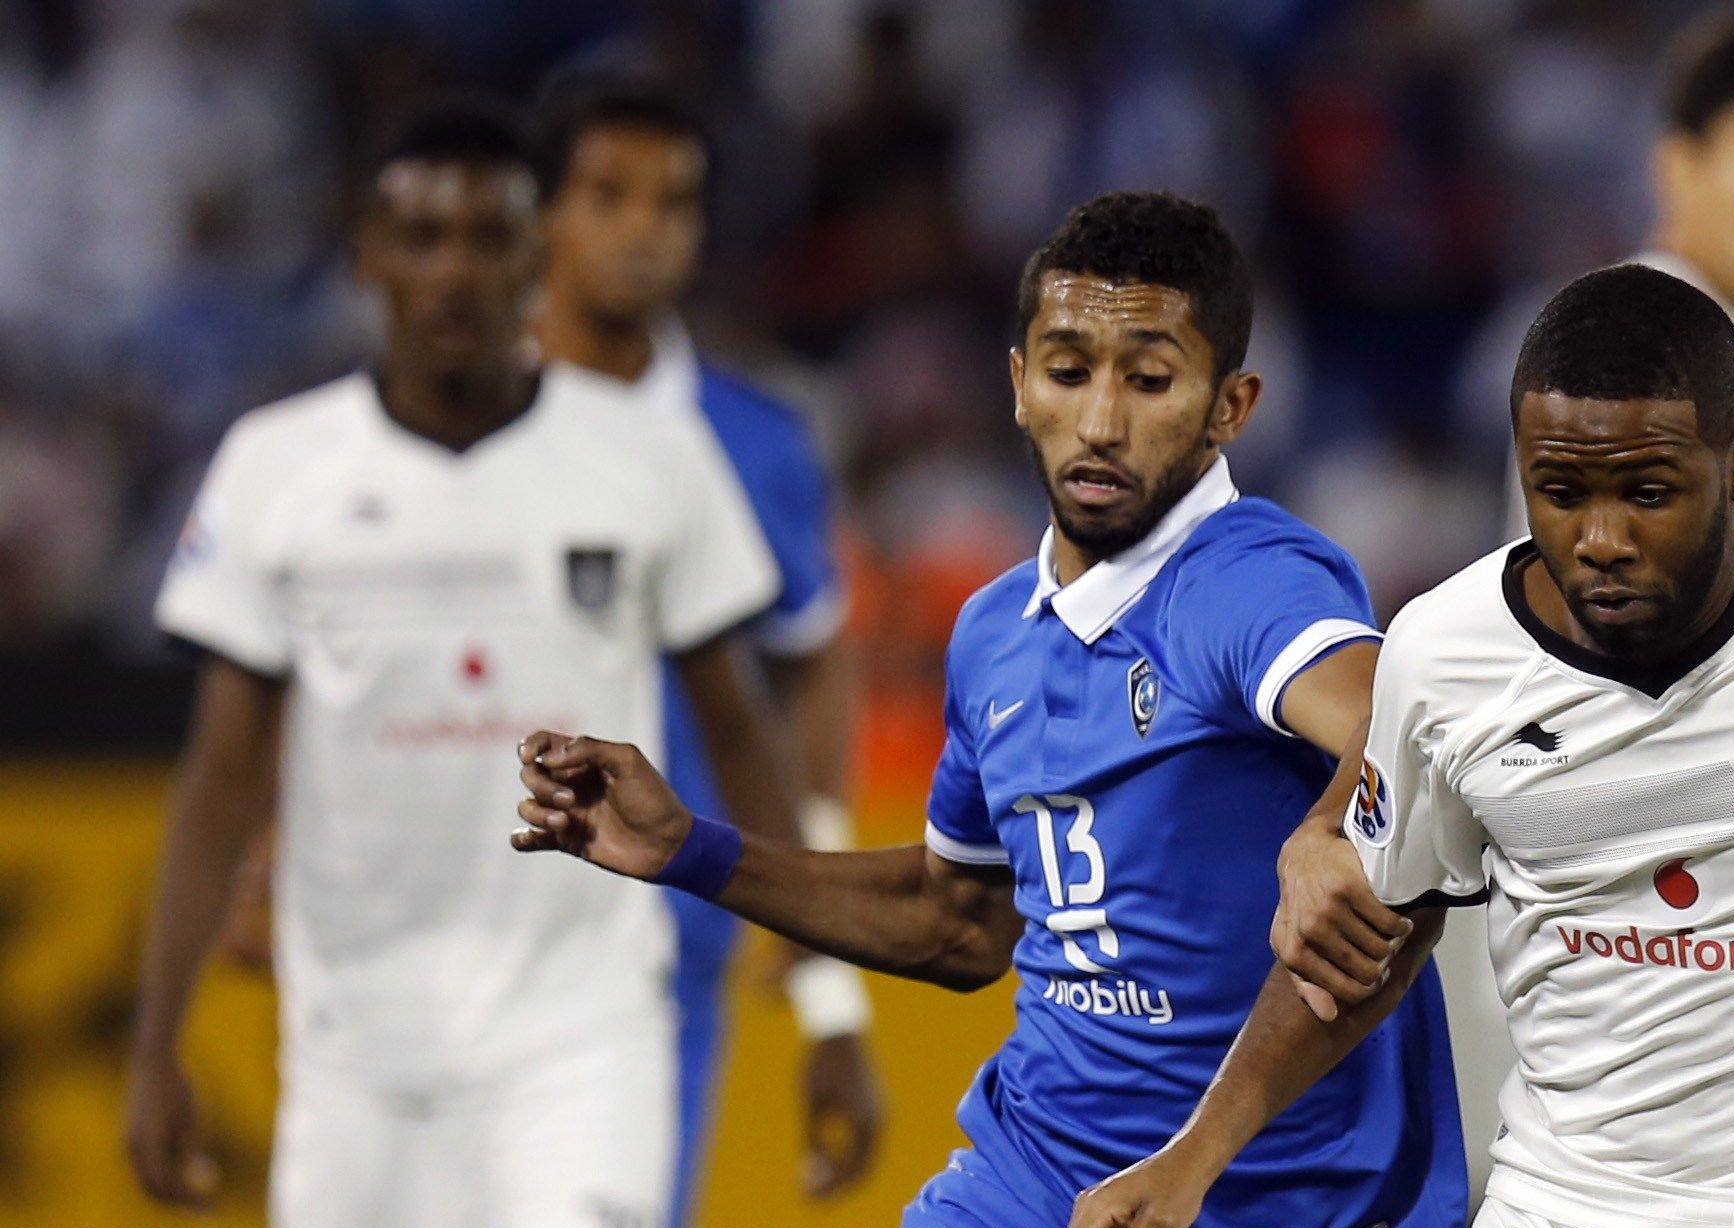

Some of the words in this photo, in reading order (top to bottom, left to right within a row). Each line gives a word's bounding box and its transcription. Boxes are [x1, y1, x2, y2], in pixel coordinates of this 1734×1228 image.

[1501, 757, 1538, 767] BURRDA
[1540, 755, 1569, 766] SPORT
[1012, 793, 1106, 907] 13
